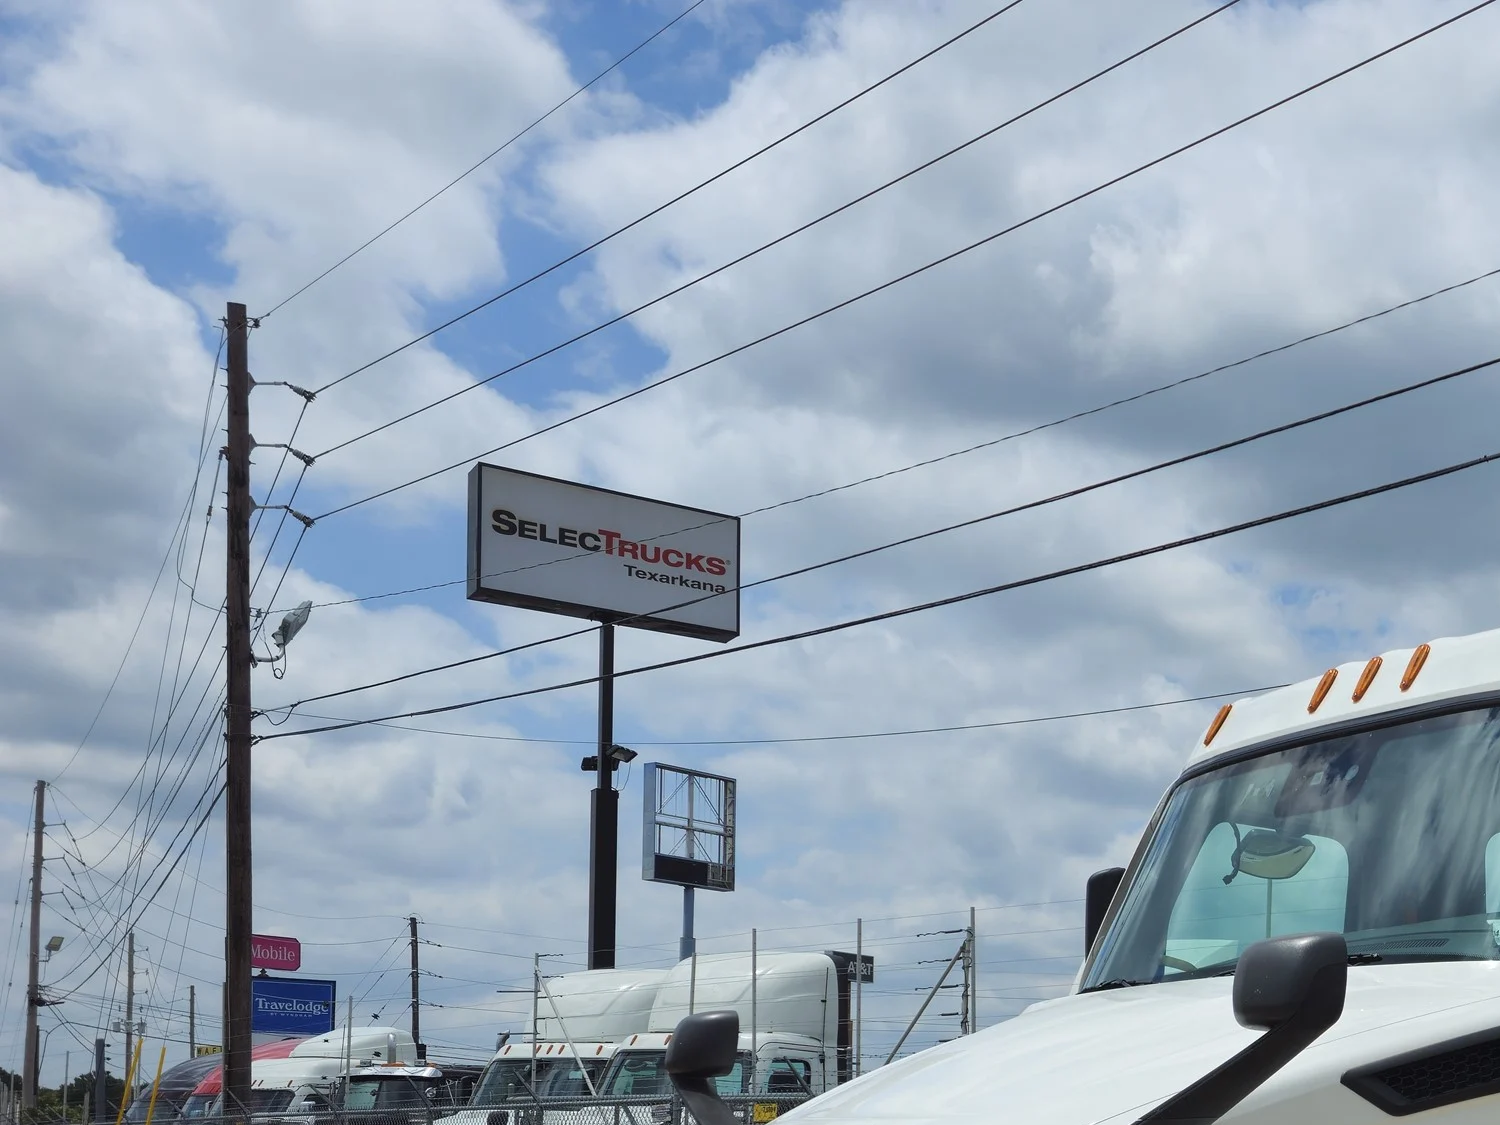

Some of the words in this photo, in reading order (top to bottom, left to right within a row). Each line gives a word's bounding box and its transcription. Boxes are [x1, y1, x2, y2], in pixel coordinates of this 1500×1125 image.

[623, 564, 726, 595] Texarkana
[847, 960, 873, 976] A&T
[254, 997, 329, 1016] Travelodge
